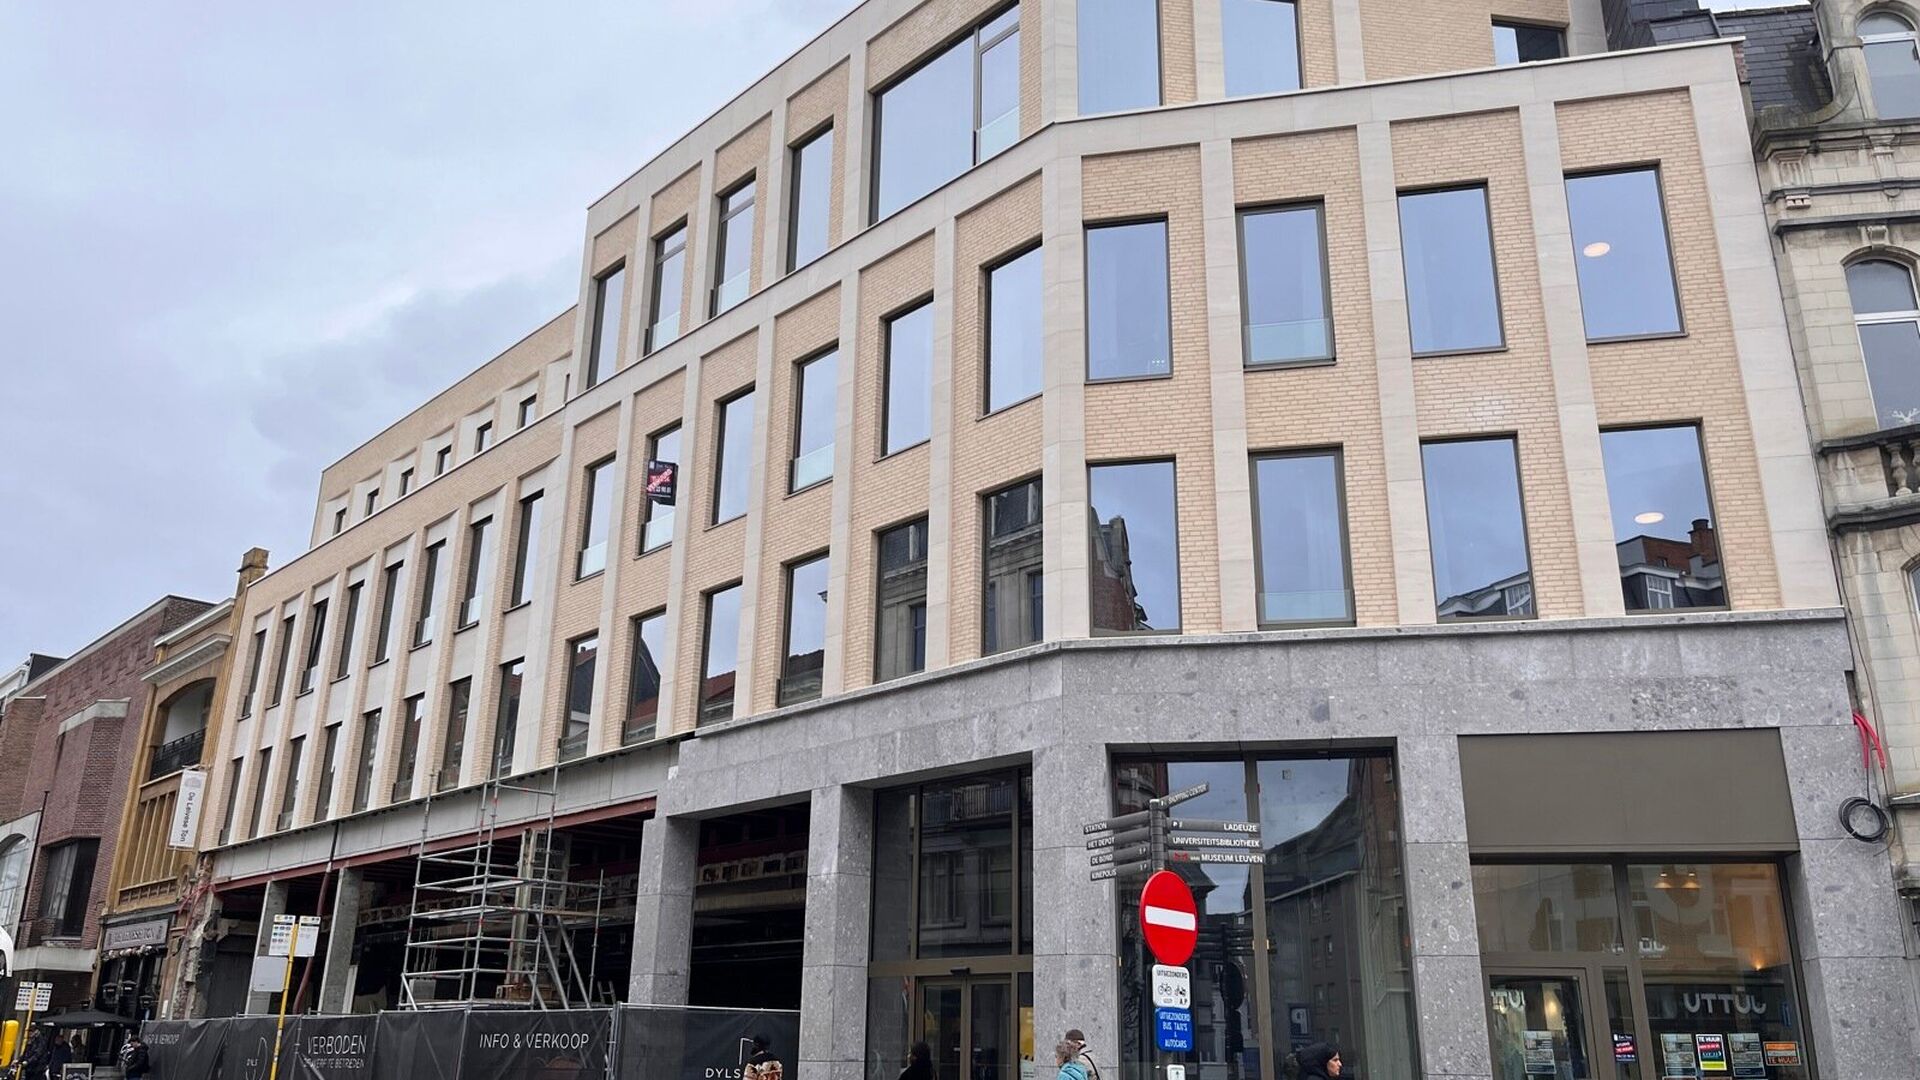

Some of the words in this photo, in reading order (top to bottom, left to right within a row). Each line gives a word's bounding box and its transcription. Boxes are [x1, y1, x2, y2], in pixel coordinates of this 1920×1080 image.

[1085, 822, 1107, 833] STATION
[1223, 823, 1257, 832] LADEUZE
[1087, 840, 1098, 849] HET
[1098, 837, 1115, 847] DEPOT
[1172, 837, 1260, 847] UNIVERSITEITSBIBLIOTHEEK
[1091, 856, 1099, 865] DE
[1201, 853, 1234, 862] MUSEUM
[1235, 854, 1263, 863] LEUVEN
[1091, 868, 1117, 880] KINEPOLIS
[1159, 1011, 1191, 1021] UITGEZONDERD
[307, 1035, 367, 1055] VERBODEN
[479, 1033, 510, 1049] INFO
[513, 1033, 522, 1049] &
[526, 1033, 590, 1049] VERKOOP
[1164, 1038, 1188, 1048] AUTOCARS
